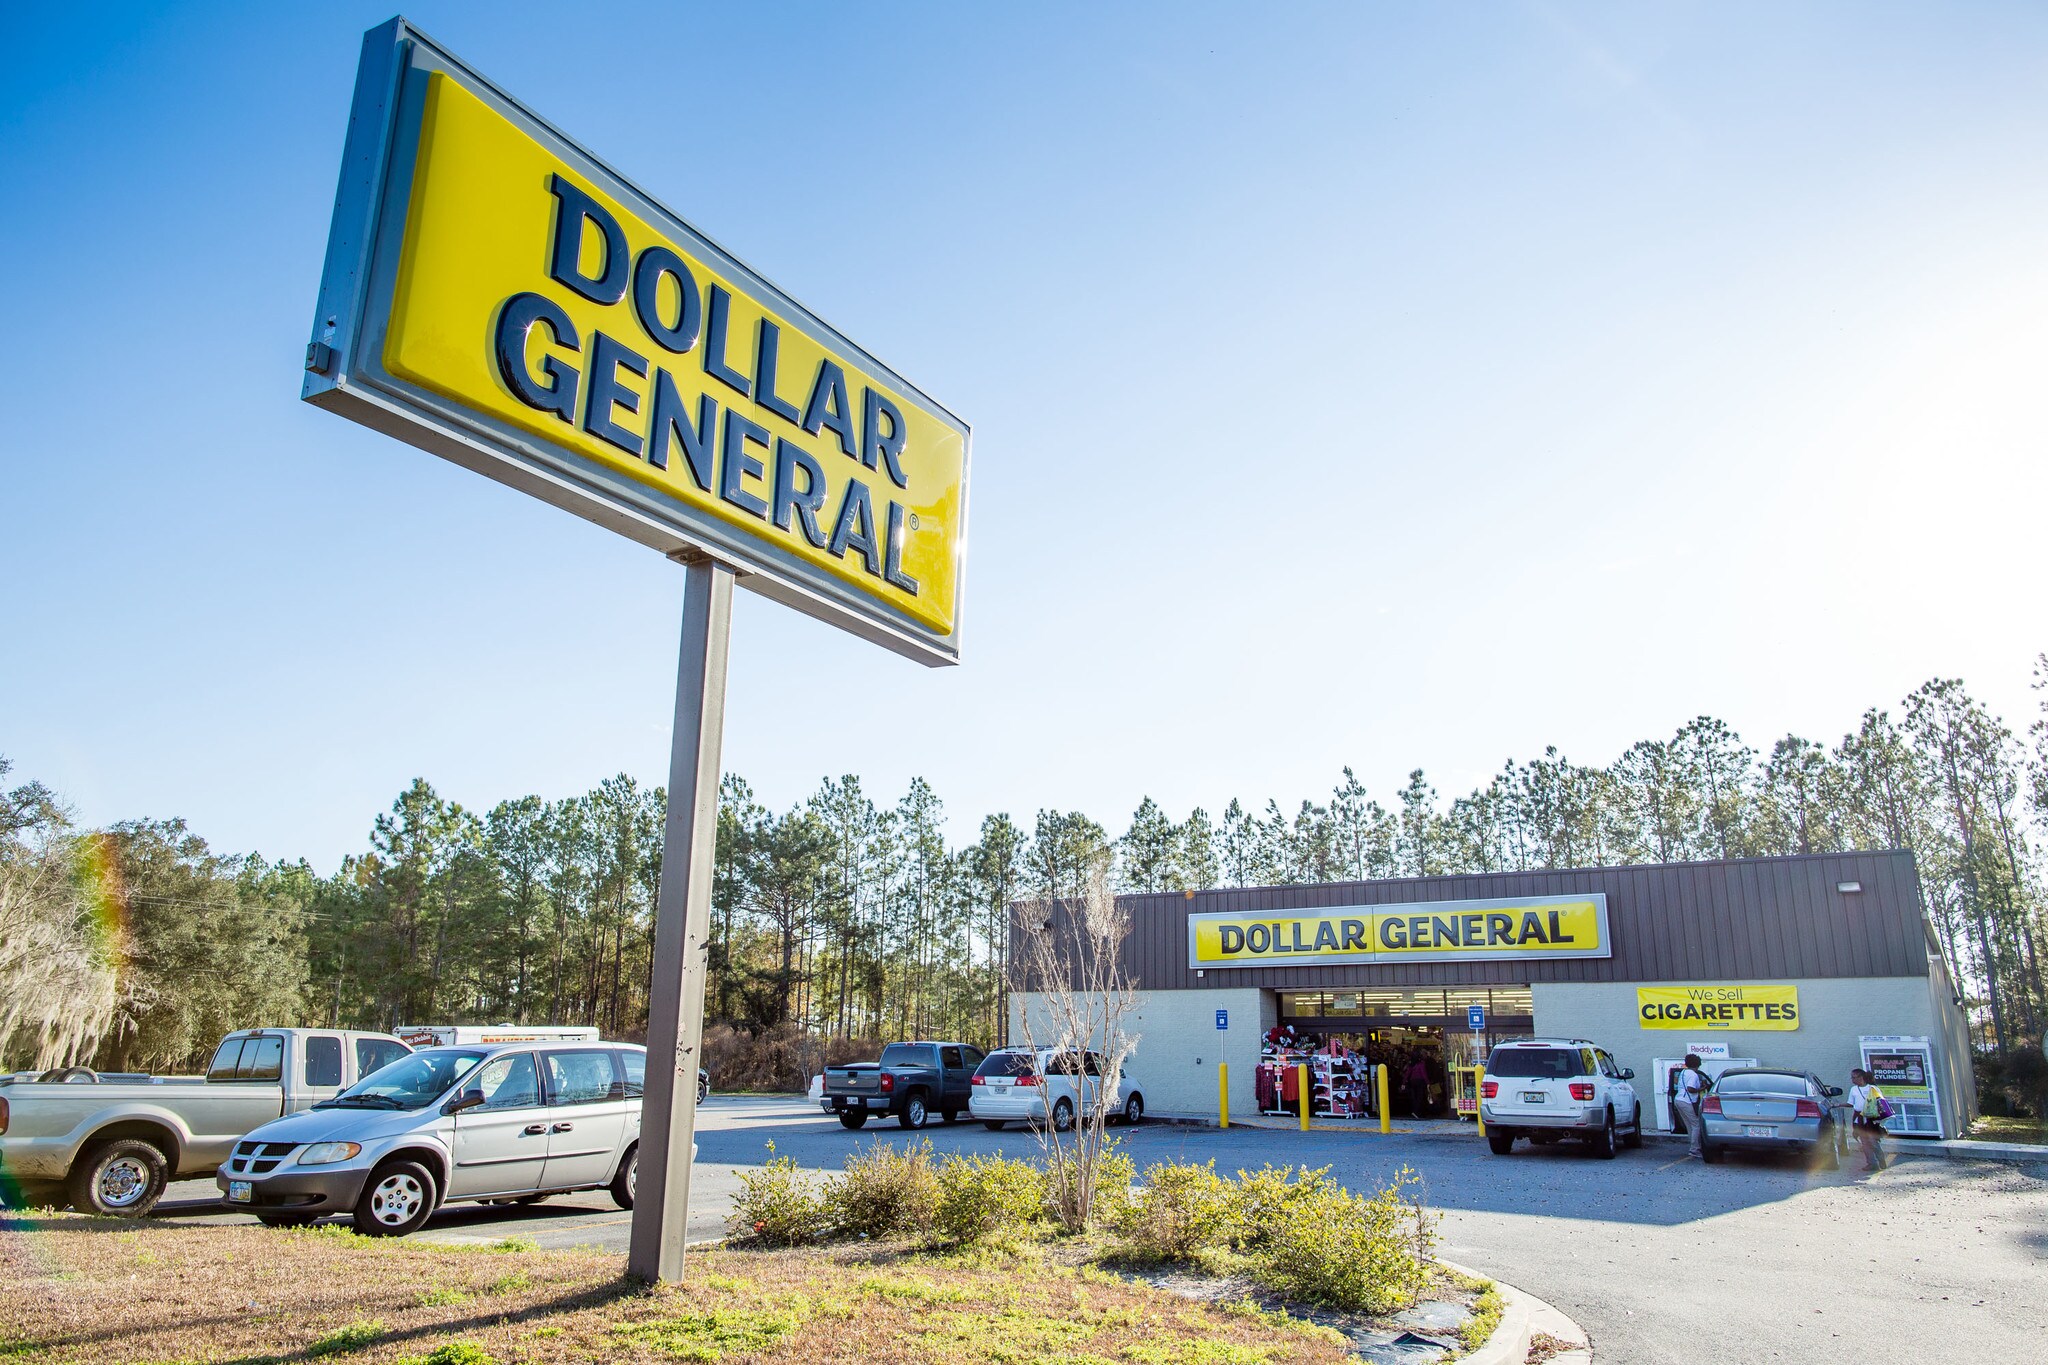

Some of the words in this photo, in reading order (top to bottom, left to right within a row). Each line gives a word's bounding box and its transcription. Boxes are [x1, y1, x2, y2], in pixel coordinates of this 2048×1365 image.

[549, 172, 908, 489] DOLLAR
[492, 291, 919, 597] GENERAL
[1218, 918, 1368, 955] DOLLAR
[1379, 910, 1575, 950] GENERAL
[1641, 1003, 1797, 1020] CIGARETTES
[1688, 988, 1713, 1001] We
[1717, 988, 1743, 1001] Sell
